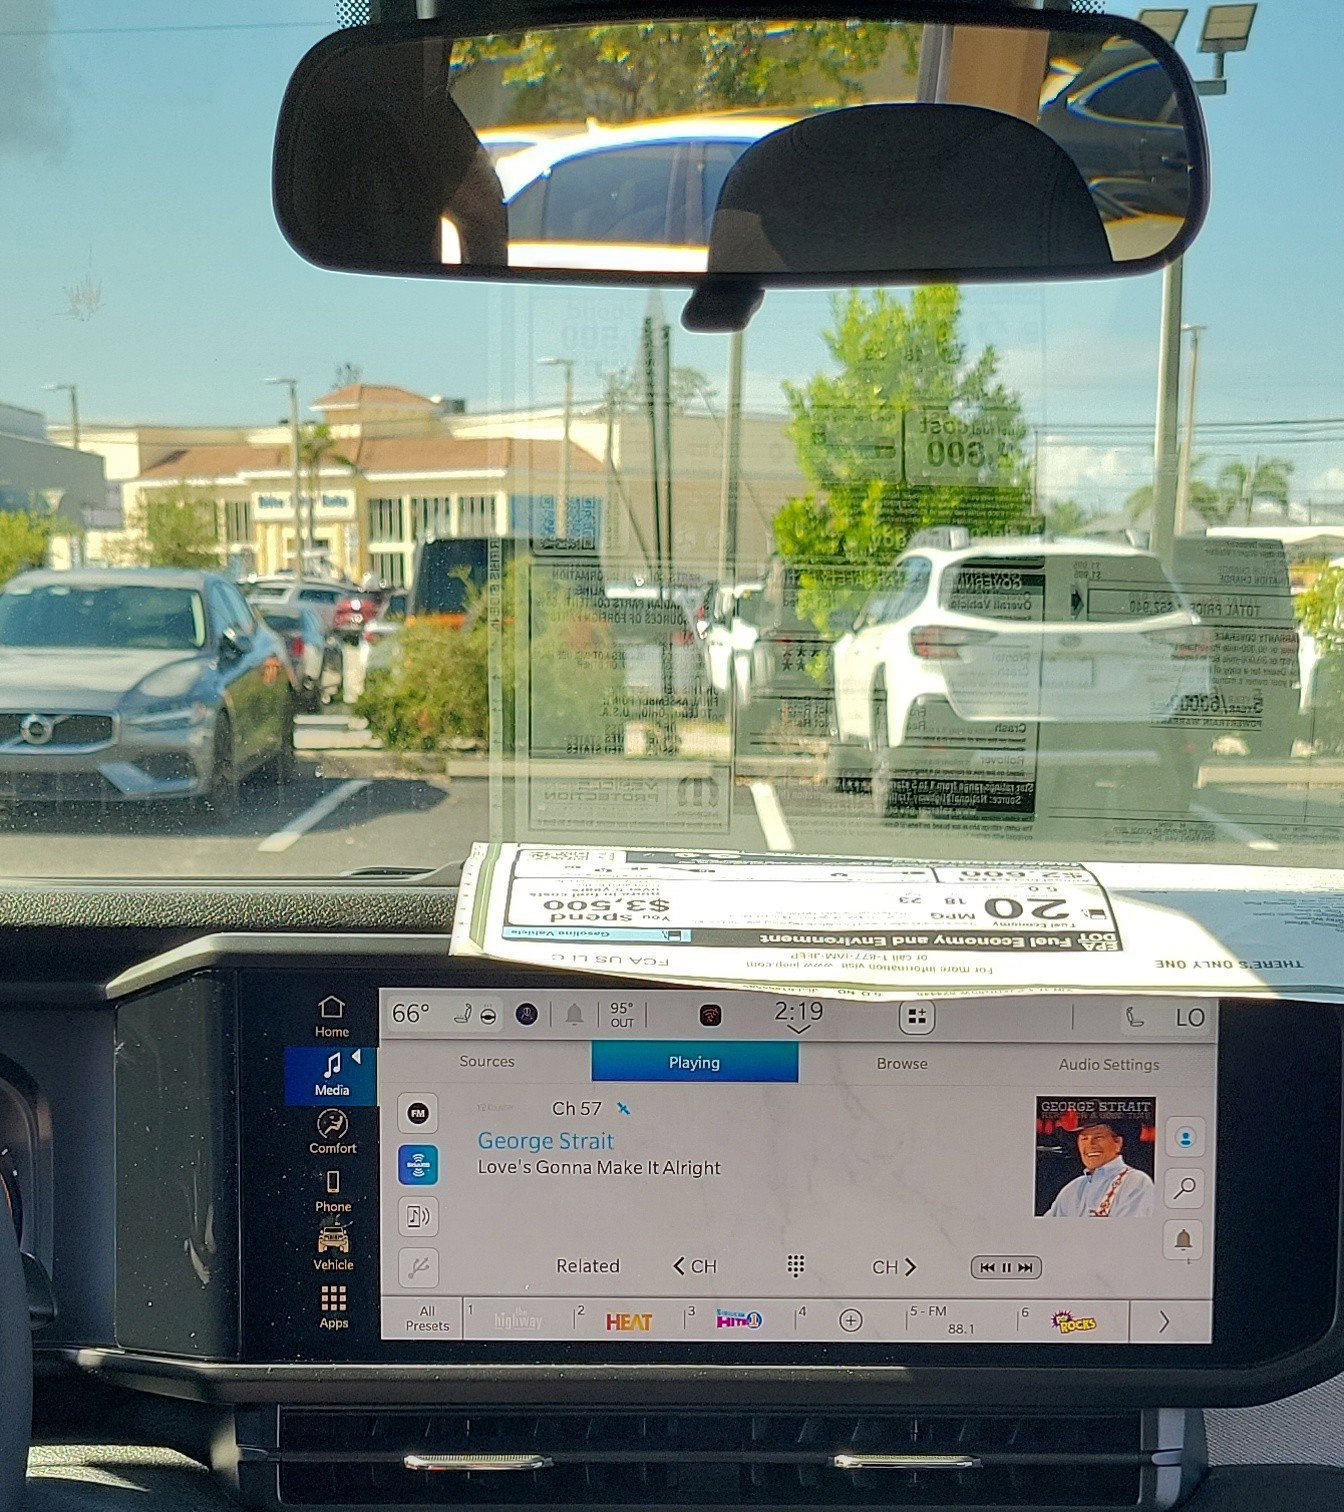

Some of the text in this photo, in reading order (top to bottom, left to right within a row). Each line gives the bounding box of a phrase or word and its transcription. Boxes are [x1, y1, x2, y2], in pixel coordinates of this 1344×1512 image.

[542, 899, 670, 913] $3,500
[984, 897, 1070, 919] 20
[549, 913, 633, 923] Spend
[929, 912, 976, 920] MPG
[511, 929, 610, 938] Gasoline Vehicle
[1078, 932, 1117, 942] DOT
[759, 934, 1072, 948] Fuel Economy and Environment
[1082, 941, 1119, 951] EPA
[595, 955, 669, 967] FCA US
[1155, 959, 1304, 970] THERE'S ONLY ONE
[391, 1001, 1205, 1027] 66° 95° 2:19 LO
[610, 1017, 634, 1029] OUT
[315, 1025, 350, 1038] Home
[459, 1055, 929, 1073] Sources Playing Browse
[1059, 1058, 1160, 1074] Audio Settings
[315, 1083, 350, 1097] Media
[552, 1101, 602, 1116] Ch 57
[1041, 1101, 1151, 1112] GEORGE STRAIT
[410, 1109, 426, 1119] FM
[309, 1141, 358, 1155] Comfort
[477, 1131, 615, 1154] George Strait
[477, 1159, 722, 1179] Love's Gonna Make It Alright
[315, 1200, 352, 1213] Phone
[313, 1258, 355, 1271] Vehicle
[556, 1257, 899, 1276] Related CH CH
[419, 1304, 436, 1317] All
[687, 1305, 697, 1317] 3
[798, 1305, 807, 1317] 4
[928, 1306, 947, 1317] FM
[319, 1316, 349, 1331] Apps
[494, 1313, 544, 1331] highway
[577, 1305, 654, 1332] 2 HEAT
[1021, 1306, 1029, 1318] 6
[1060, 1318, 1097, 1334] ROCKS
[405, 1319, 450, 1334] Presets
[948, 1324, 975, 1335] 88.1
